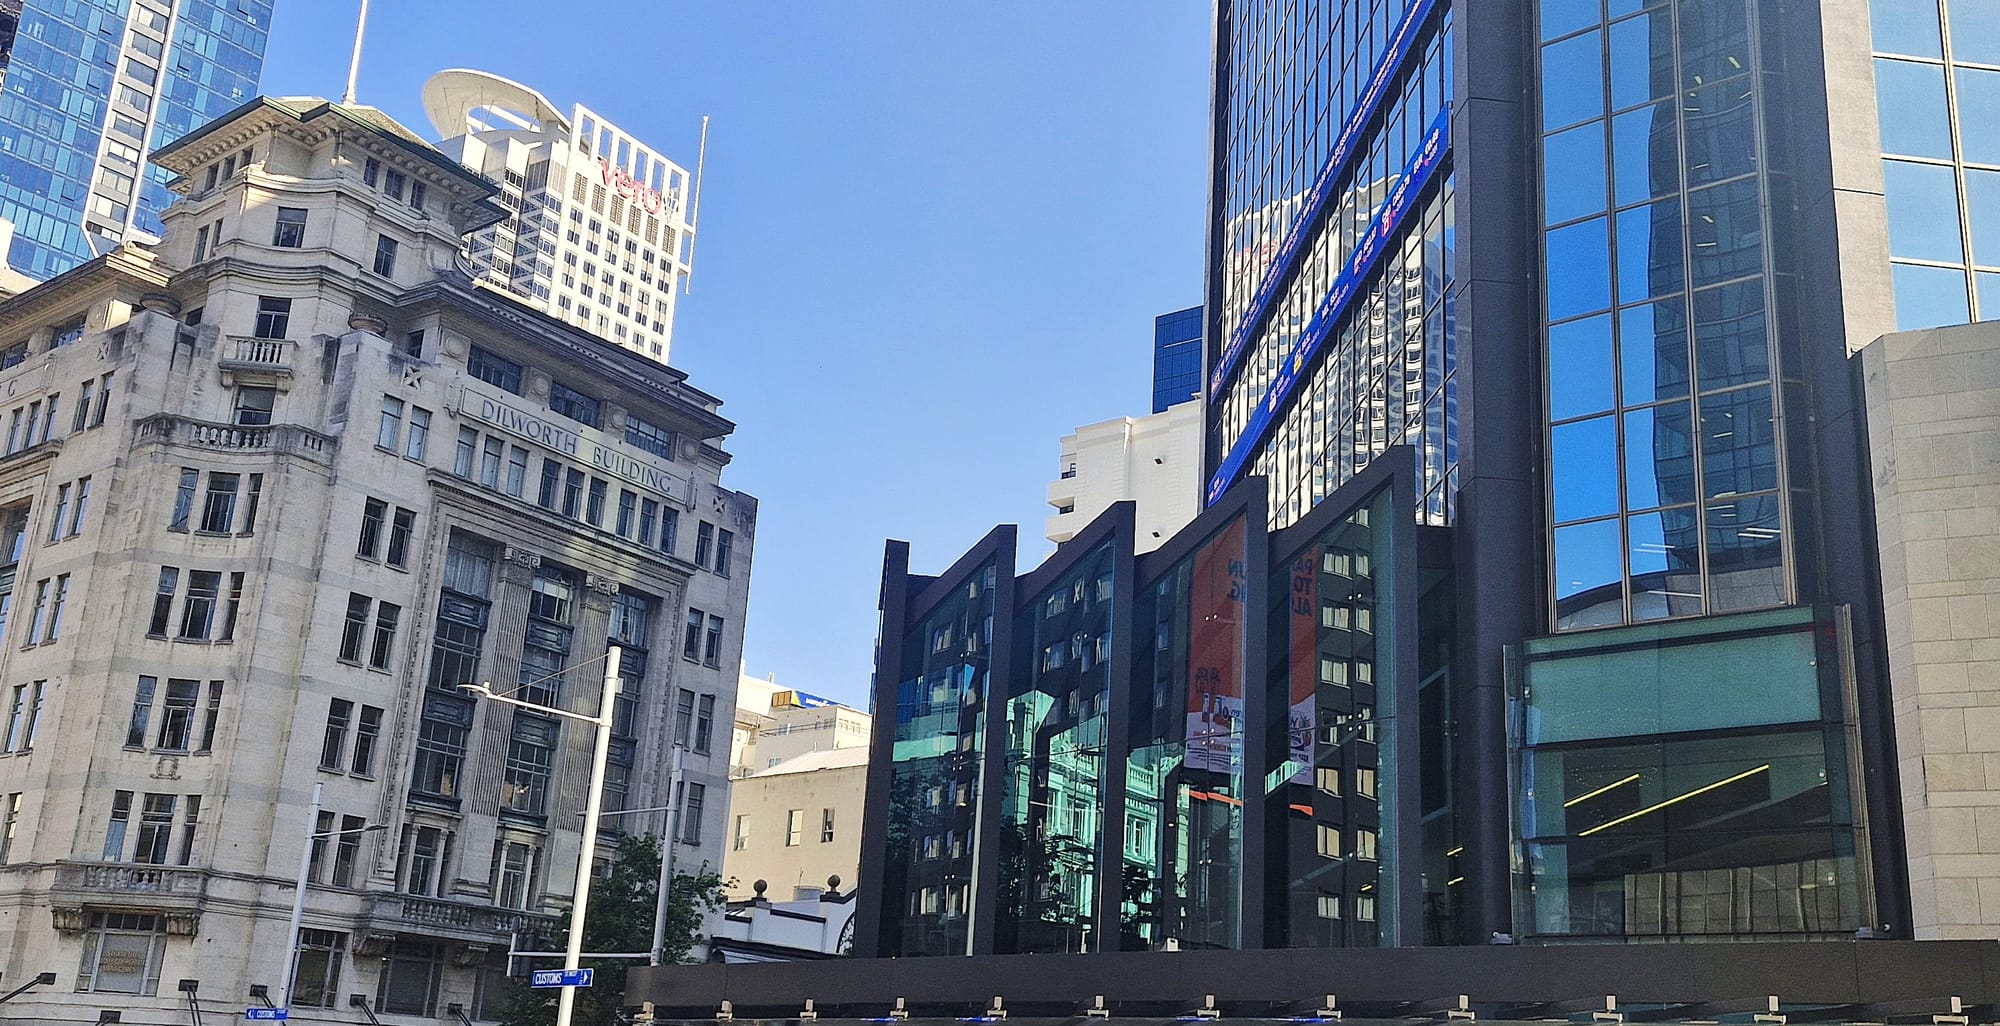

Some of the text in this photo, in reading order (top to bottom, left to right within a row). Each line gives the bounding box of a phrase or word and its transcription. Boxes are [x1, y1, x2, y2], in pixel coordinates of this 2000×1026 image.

[481, 399, 672, 493] DILWORTH BUILDING
[535, 972, 563, 985] CUSTOMS
